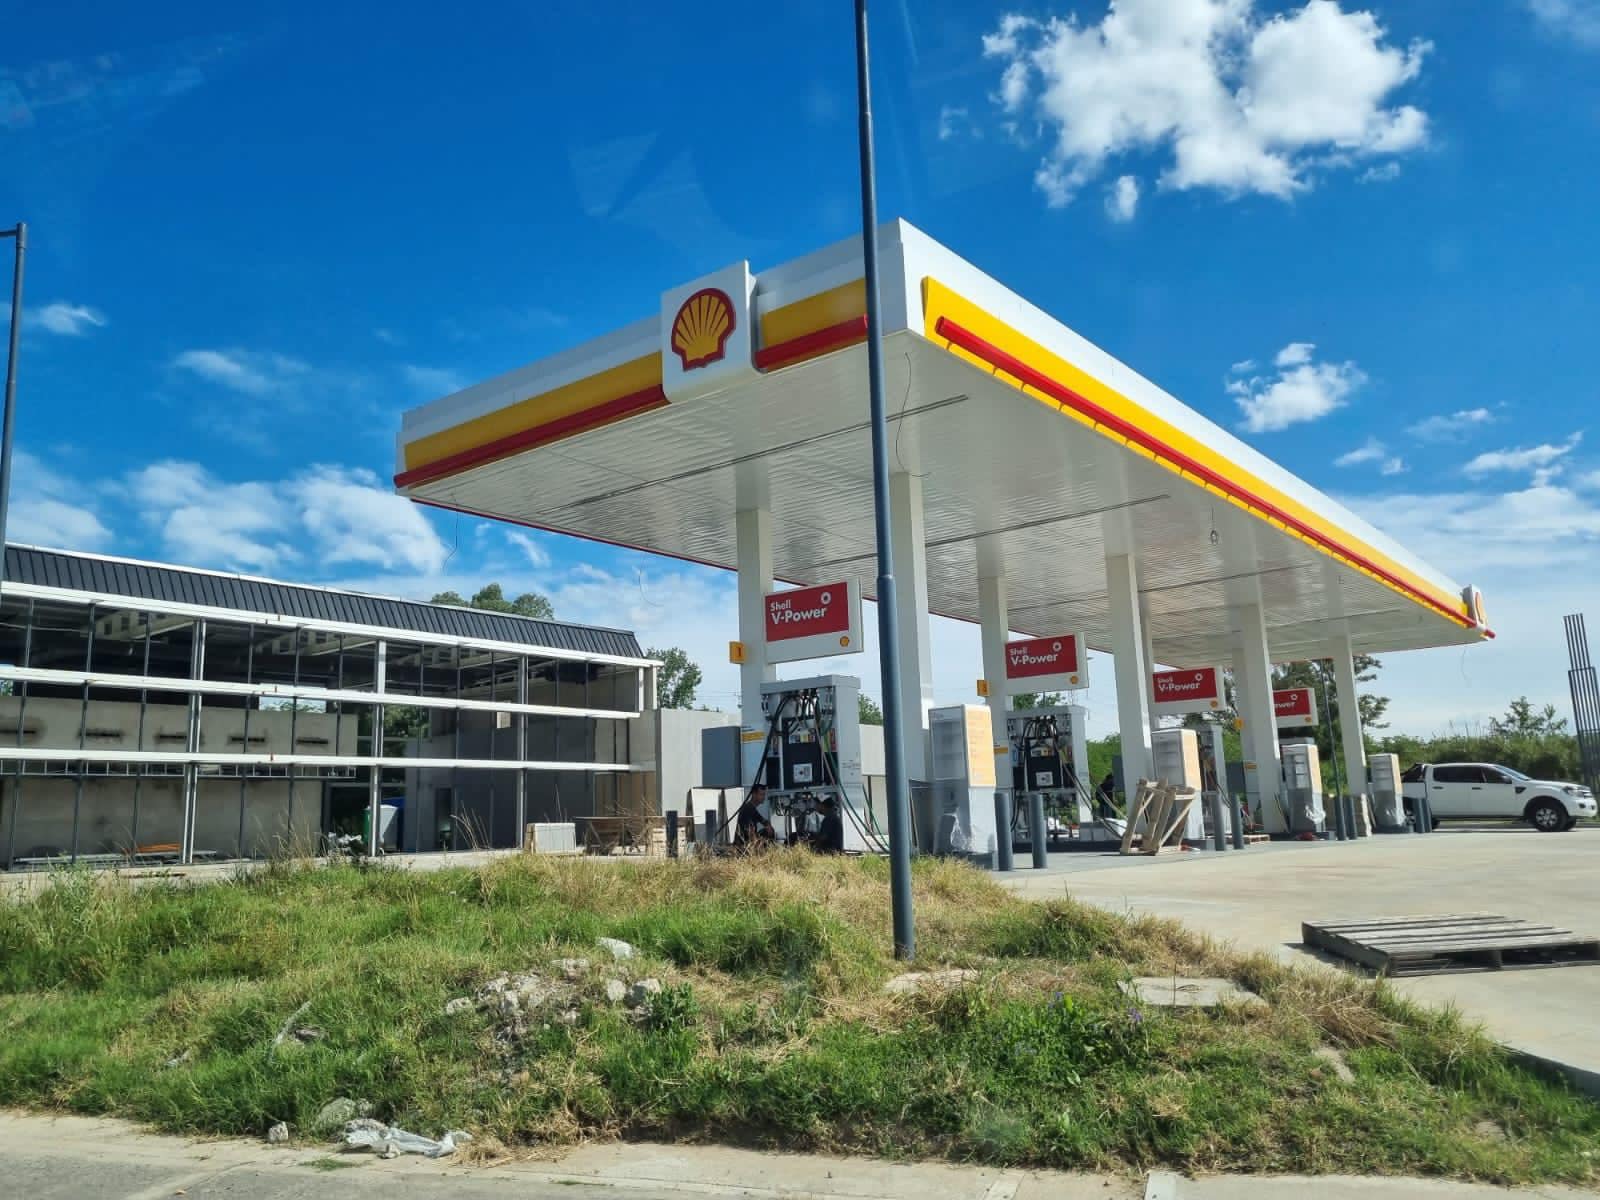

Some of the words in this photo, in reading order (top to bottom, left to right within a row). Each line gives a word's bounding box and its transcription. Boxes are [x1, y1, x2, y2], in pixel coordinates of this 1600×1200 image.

[770, 599, 791, 611] Shell
[771, 607, 827, 625] V-Power
[1011, 653, 1058, 667] V-Power
[1158, 682, 1201, 692] V-Power
